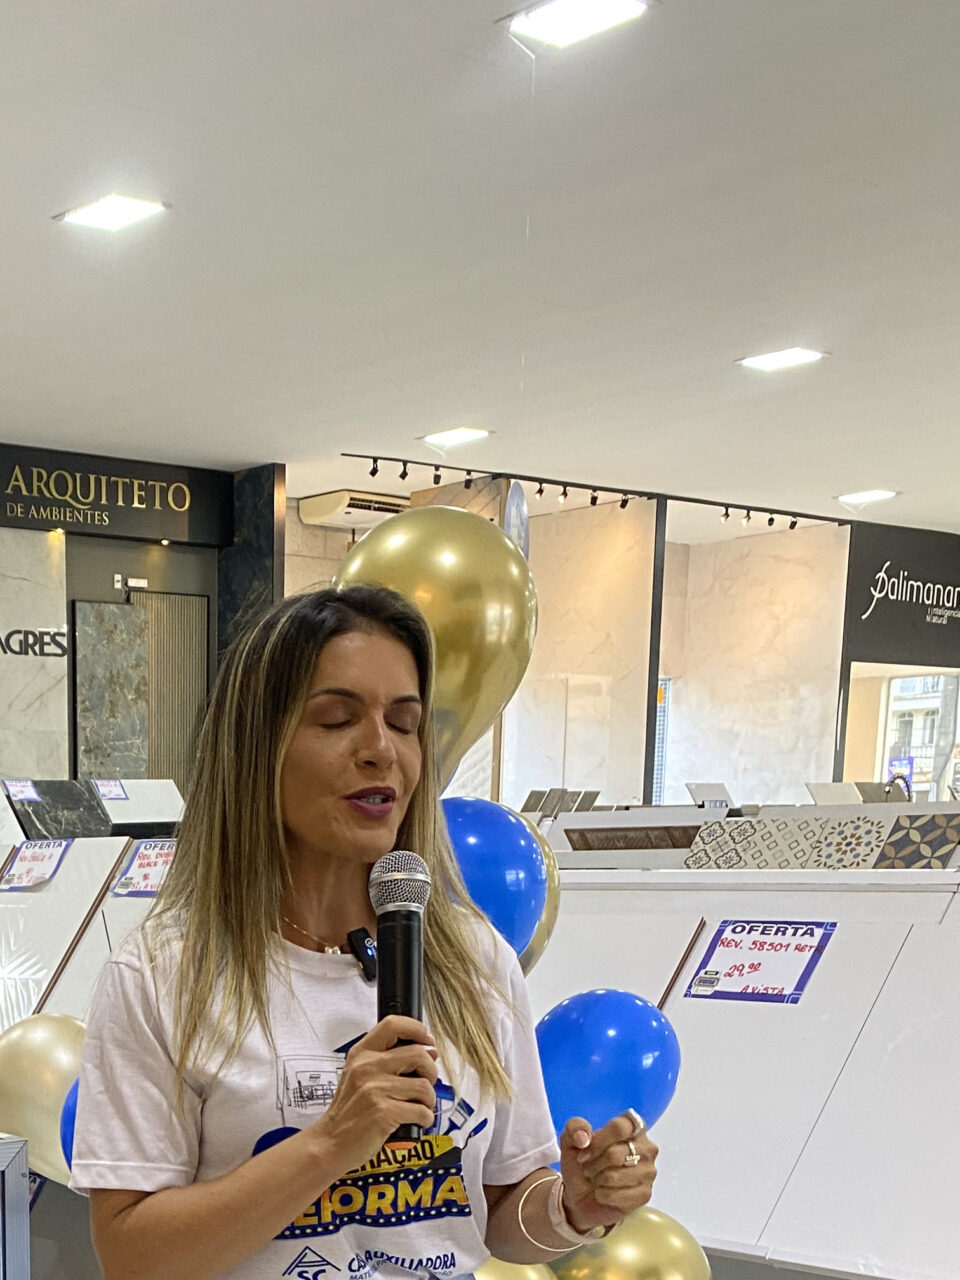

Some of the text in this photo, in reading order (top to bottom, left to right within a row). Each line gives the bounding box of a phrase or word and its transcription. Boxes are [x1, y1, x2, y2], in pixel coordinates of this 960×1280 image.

[5, 464, 191, 512] ARQUITETO
[7, 502, 25, 518] DE
[28, 504, 110, 526] AMBIENTES
[24, 841, 63, 850] OFERTA
[143, 843, 175, 851] OFER
[731, 924, 816, 938] OFERTA
[748, 939, 792, 952] 58501
[293, 1176, 469, 1226] EFORMA
